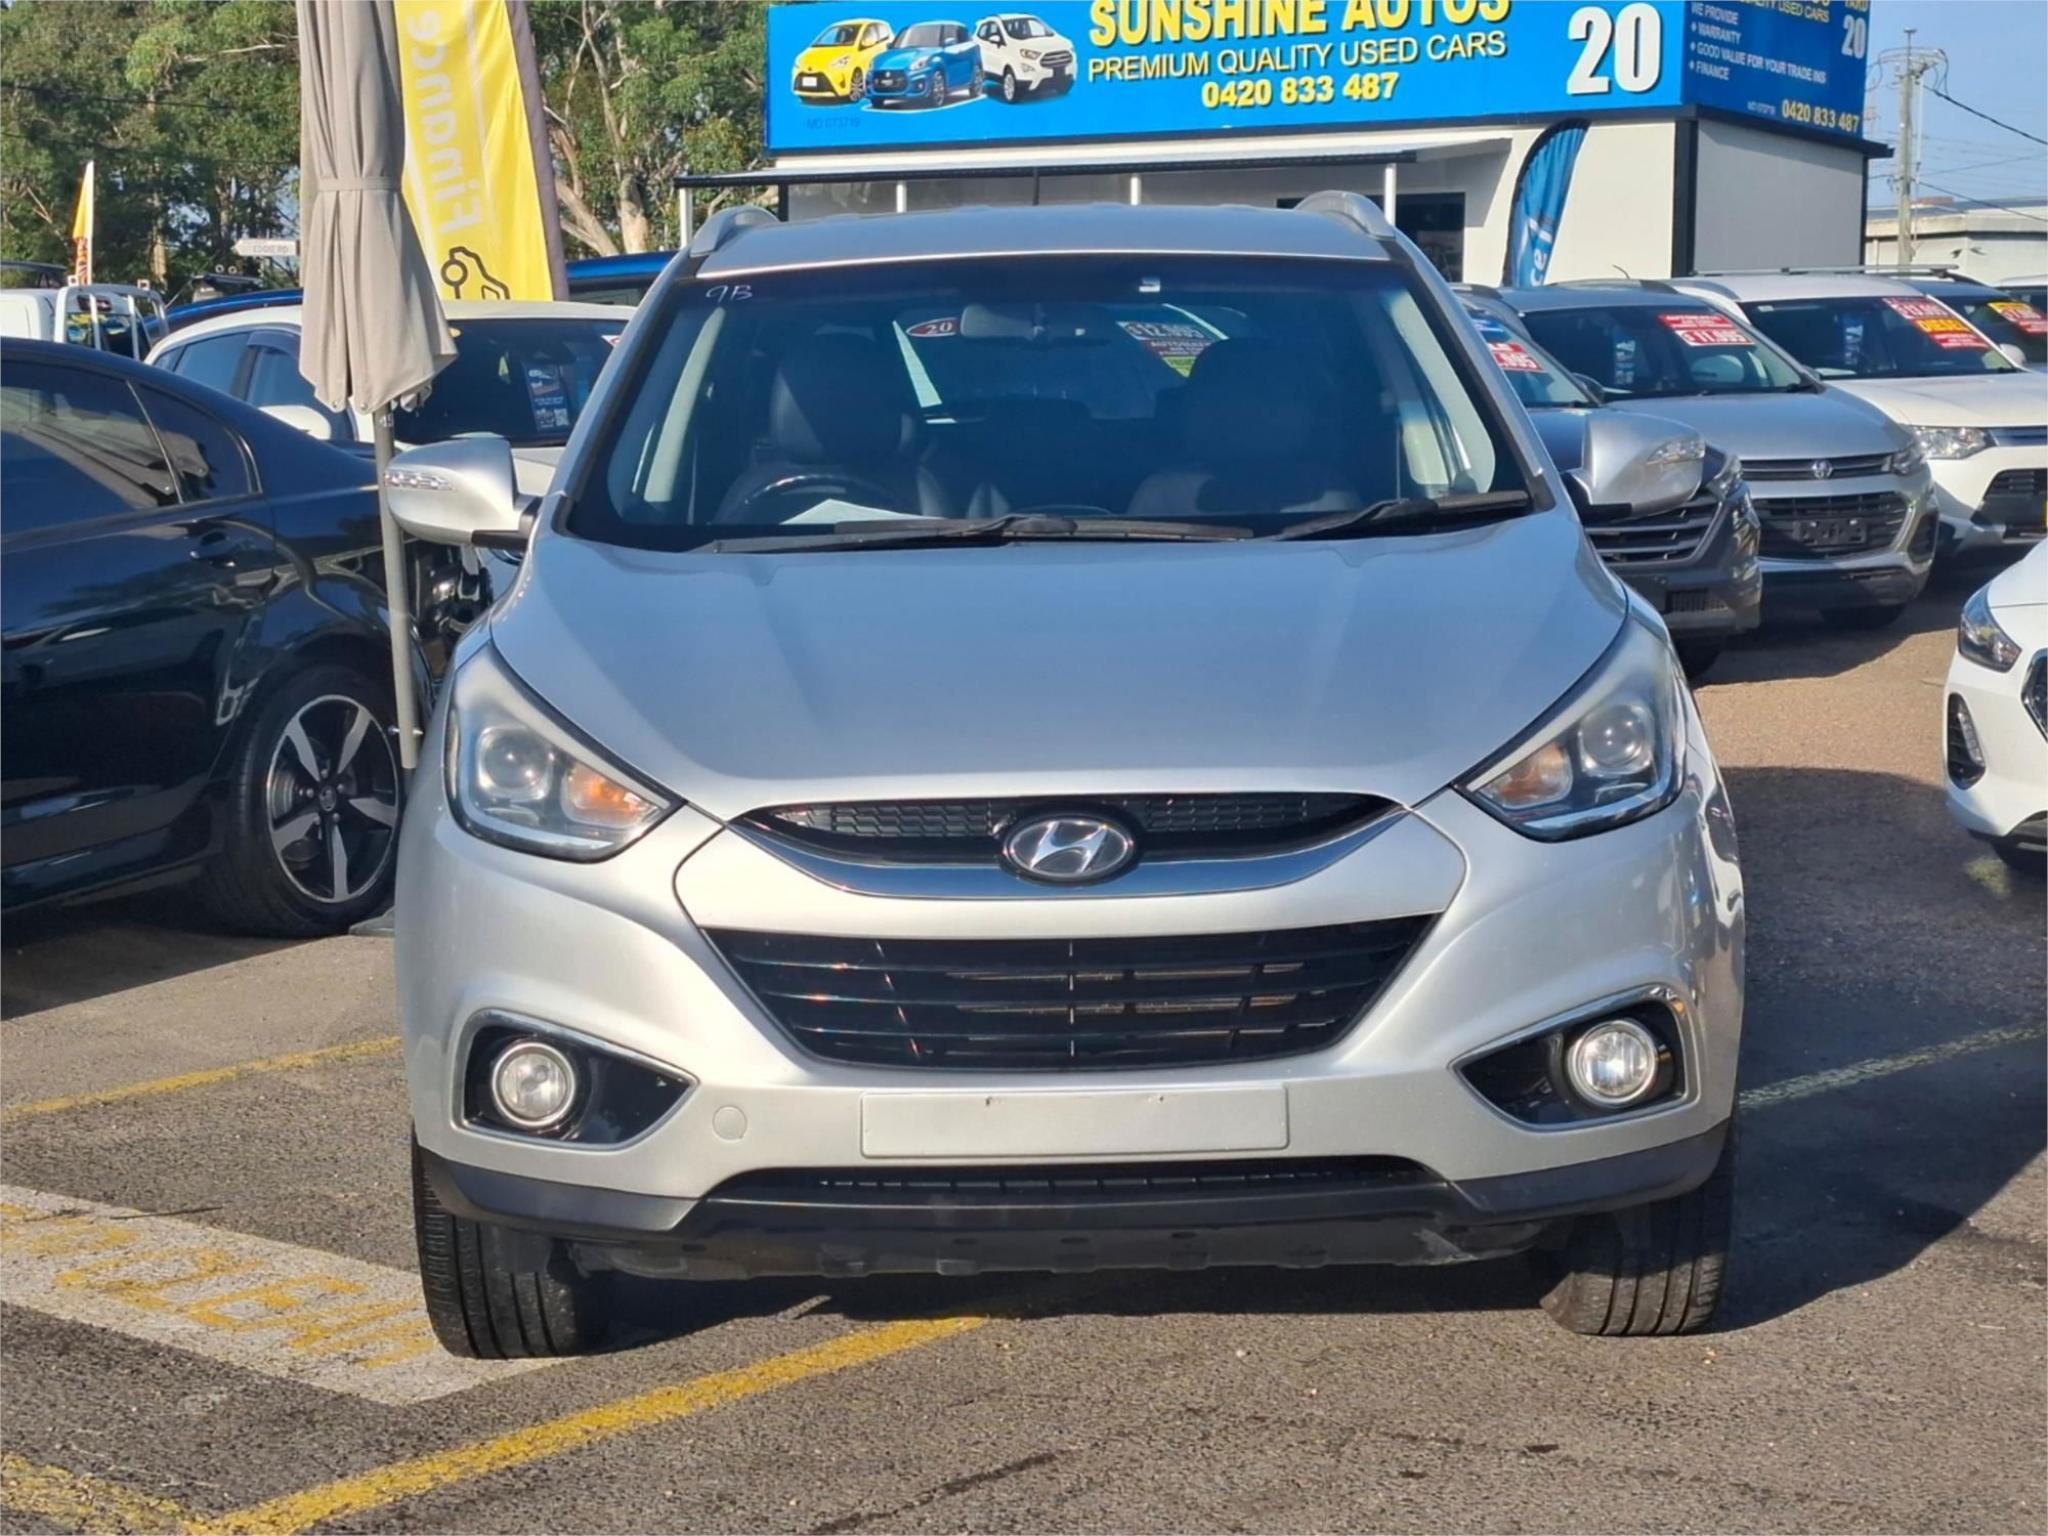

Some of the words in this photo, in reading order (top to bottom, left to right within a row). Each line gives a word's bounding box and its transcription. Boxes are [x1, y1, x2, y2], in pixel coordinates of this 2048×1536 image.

[1089, 0, 1328, 47] SUNSHINE
[1841, 14, 1867, 59] 20
[1088, 51, 1209, 82] PREMIUM
[1217, 43, 1333, 74] QUALITY
[1340, 37, 1420, 66] USED
[1427, 30, 1507, 61] CARS
[1566, 2, 1662, 96] 20
[1202, 79, 1272, 108] 0420
[1281, 75, 1334, 104] 833
[1343, 72, 1399, 100] 487
[1782, 99, 1811, 122] 0420
[1814, 106, 1836, 128] 833
[1839, 113, 1860, 132] 487
